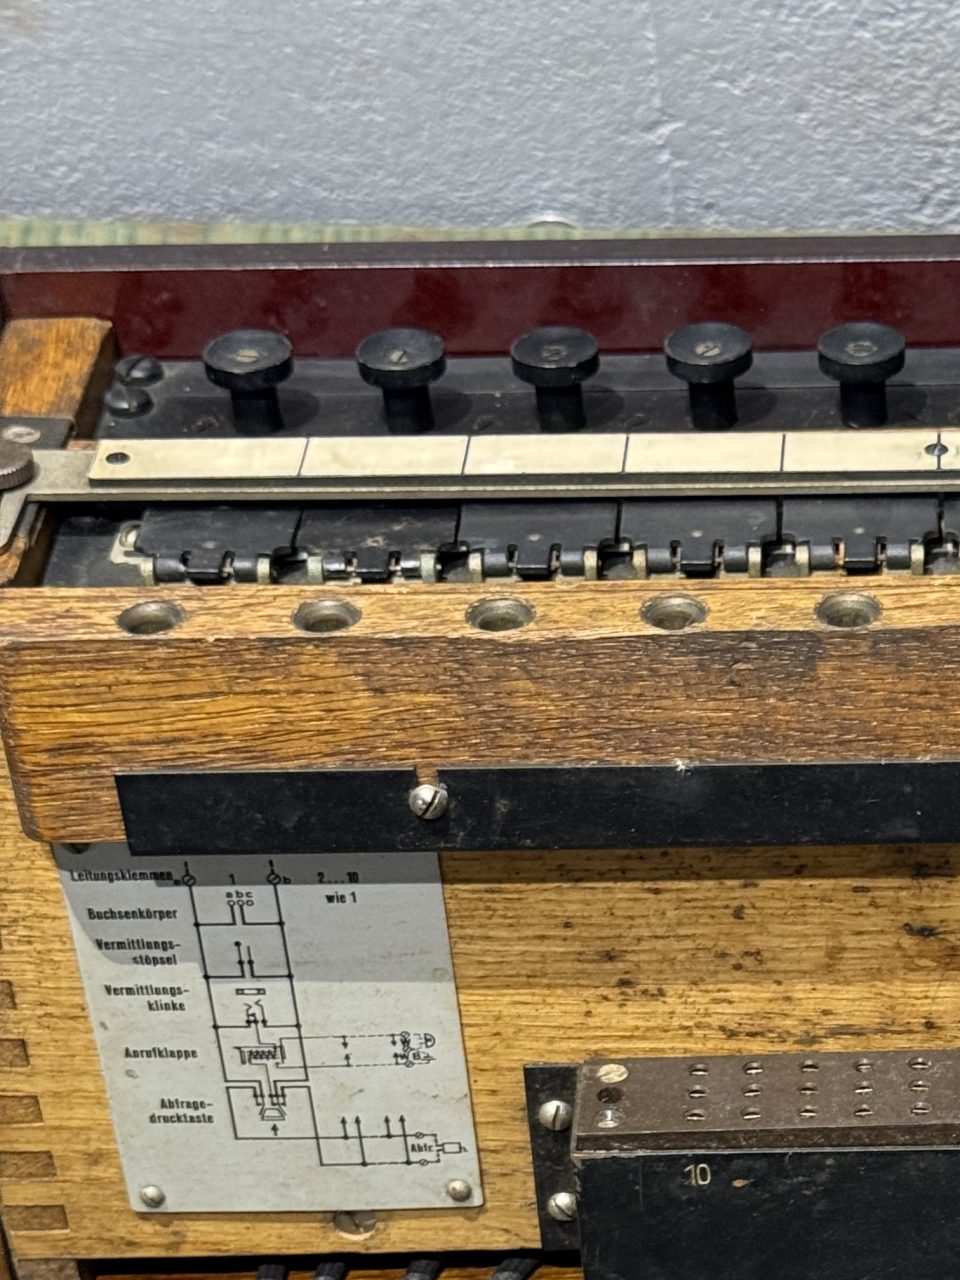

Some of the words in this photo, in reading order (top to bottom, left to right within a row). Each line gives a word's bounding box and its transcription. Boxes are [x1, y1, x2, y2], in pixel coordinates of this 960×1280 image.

[69, 869, 174, 883] Leitungsklemmen
[228, 871, 236, 885] 1
[324, 891, 348, 904] wie
[350, 890, 358, 904] 1
[87, 907, 178, 921] Buchsenkörper
[95, 938, 181, 952] Vermittlungs-
[131, 954, 178, 967] stöpsel
[104, 984, 190, 997] Vermittlungs-
[147, 999, 187, 1012] klinke
[124, 1046, 199, 1060] Anrufklappe
[160, 1098, 214, 1111] Abfrage-
[149, 1113, 215, 1124] drucktaste
[683, 1163, 711, 1186] 10
